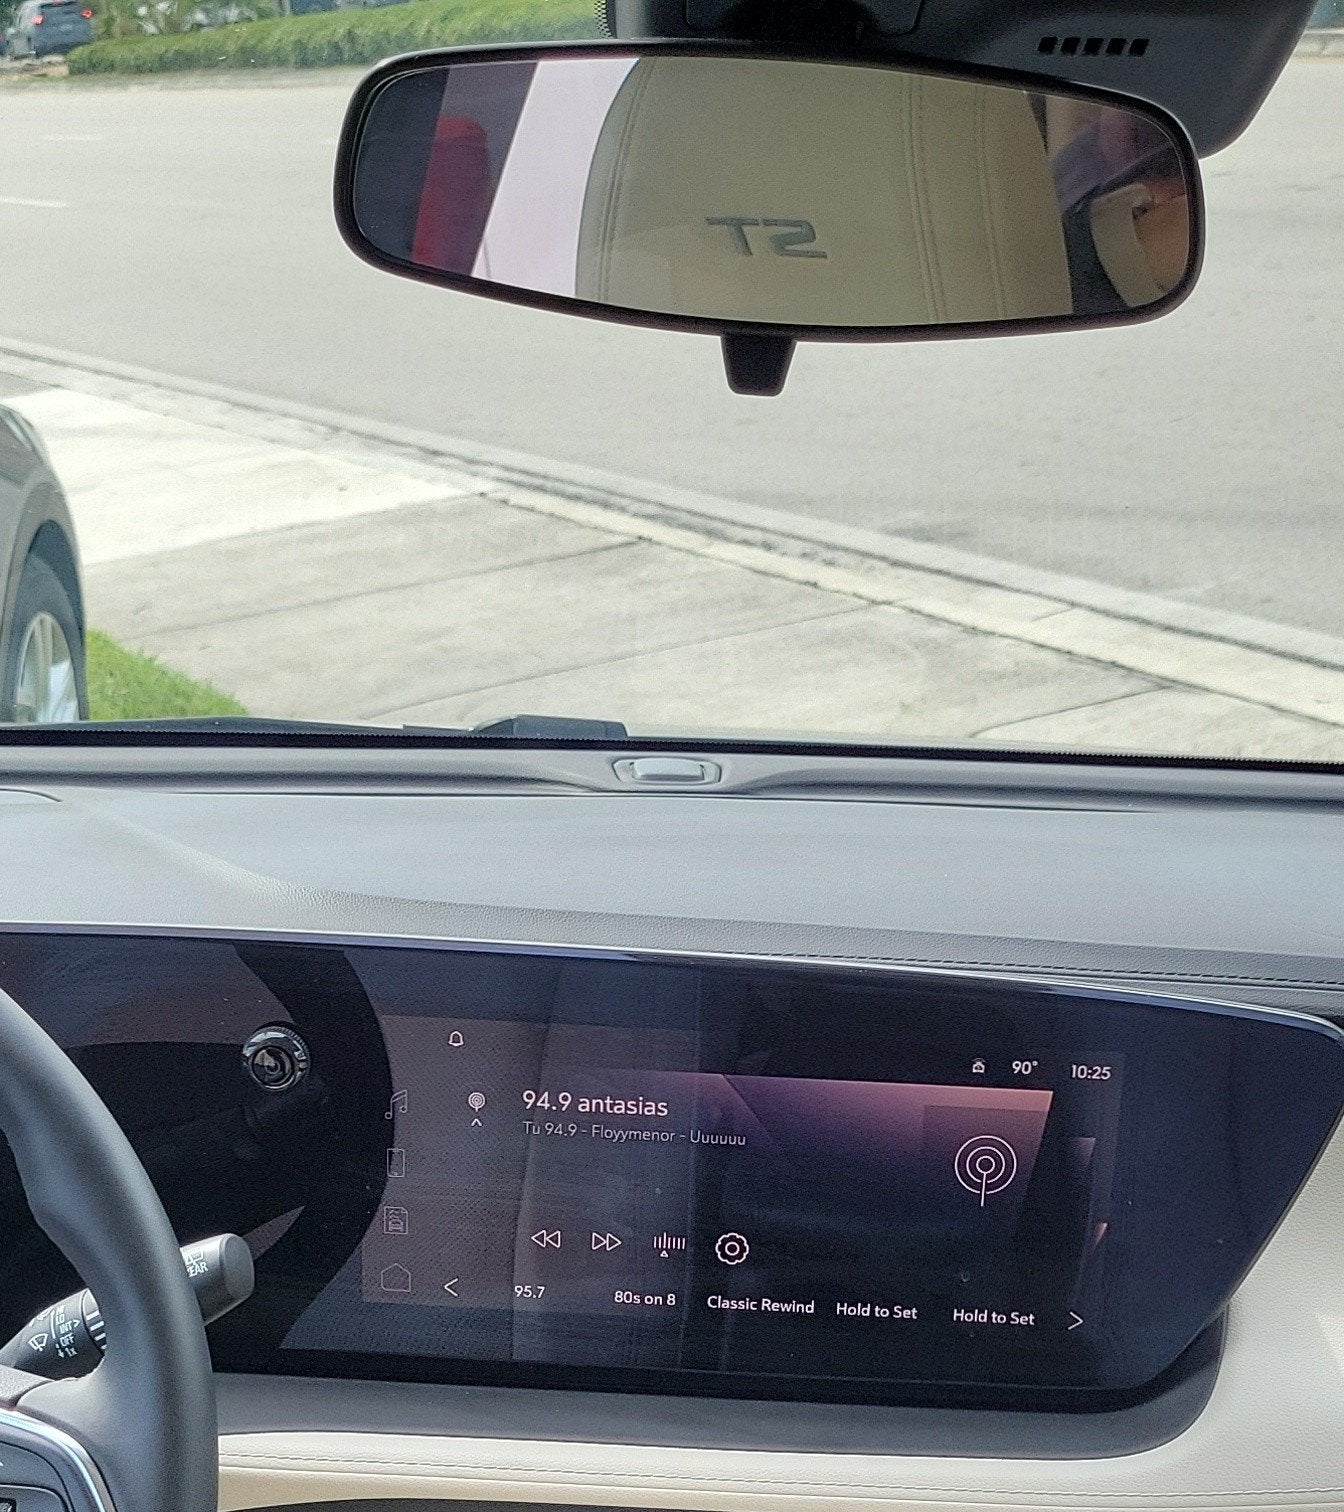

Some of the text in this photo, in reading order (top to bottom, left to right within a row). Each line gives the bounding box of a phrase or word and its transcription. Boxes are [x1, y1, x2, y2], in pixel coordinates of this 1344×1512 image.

[1070, 1064, 1111, 1081] 10:25
[522, 1090, 669, 1117] 94.9 antasias
[523, 1121, 541, 1135] Tu
[545, 1122, 577, 1137] 94.9
[591, 1124, 676, 1143] Floyymenor
[514, 1285, 546, 1299] 95.7
[614, 1291, 676, 1306] 80s on 8
[707, 1296, 815, 1314] Classic Rewind
[836, 1303, 918, 1320] Hold to Set
[953, 1308, 1035, 1326] Hold to Set
[60, 1333, 74, 1347] OFF
